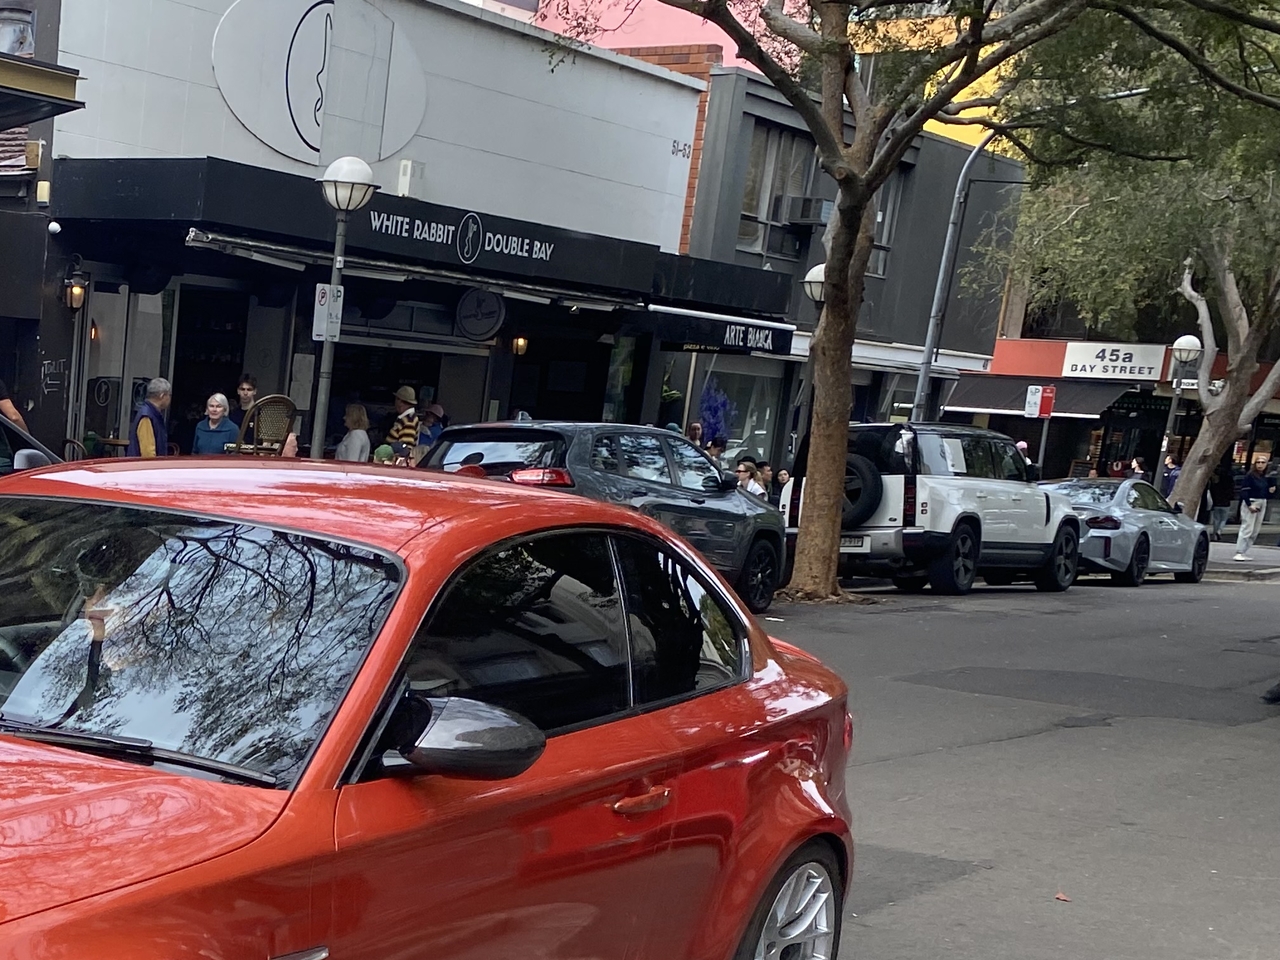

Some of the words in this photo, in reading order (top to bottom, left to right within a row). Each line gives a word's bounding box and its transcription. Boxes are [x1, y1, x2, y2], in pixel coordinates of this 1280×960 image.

[370, 211, 410, 237] WHITE
[413, 219, 455, 245] RABBIT
[485, 232, 529, 257] DOUBLE
[532, 241, 554, 261] BAY
[723, 324, 746, 346] ARTE
[747, 327, 773, 350] BIANCA
[1095, 348, 1134, 363] 45a
[1070, 364, 1096, 373] BAY
[1102, 365, 1155, 375] STREET
